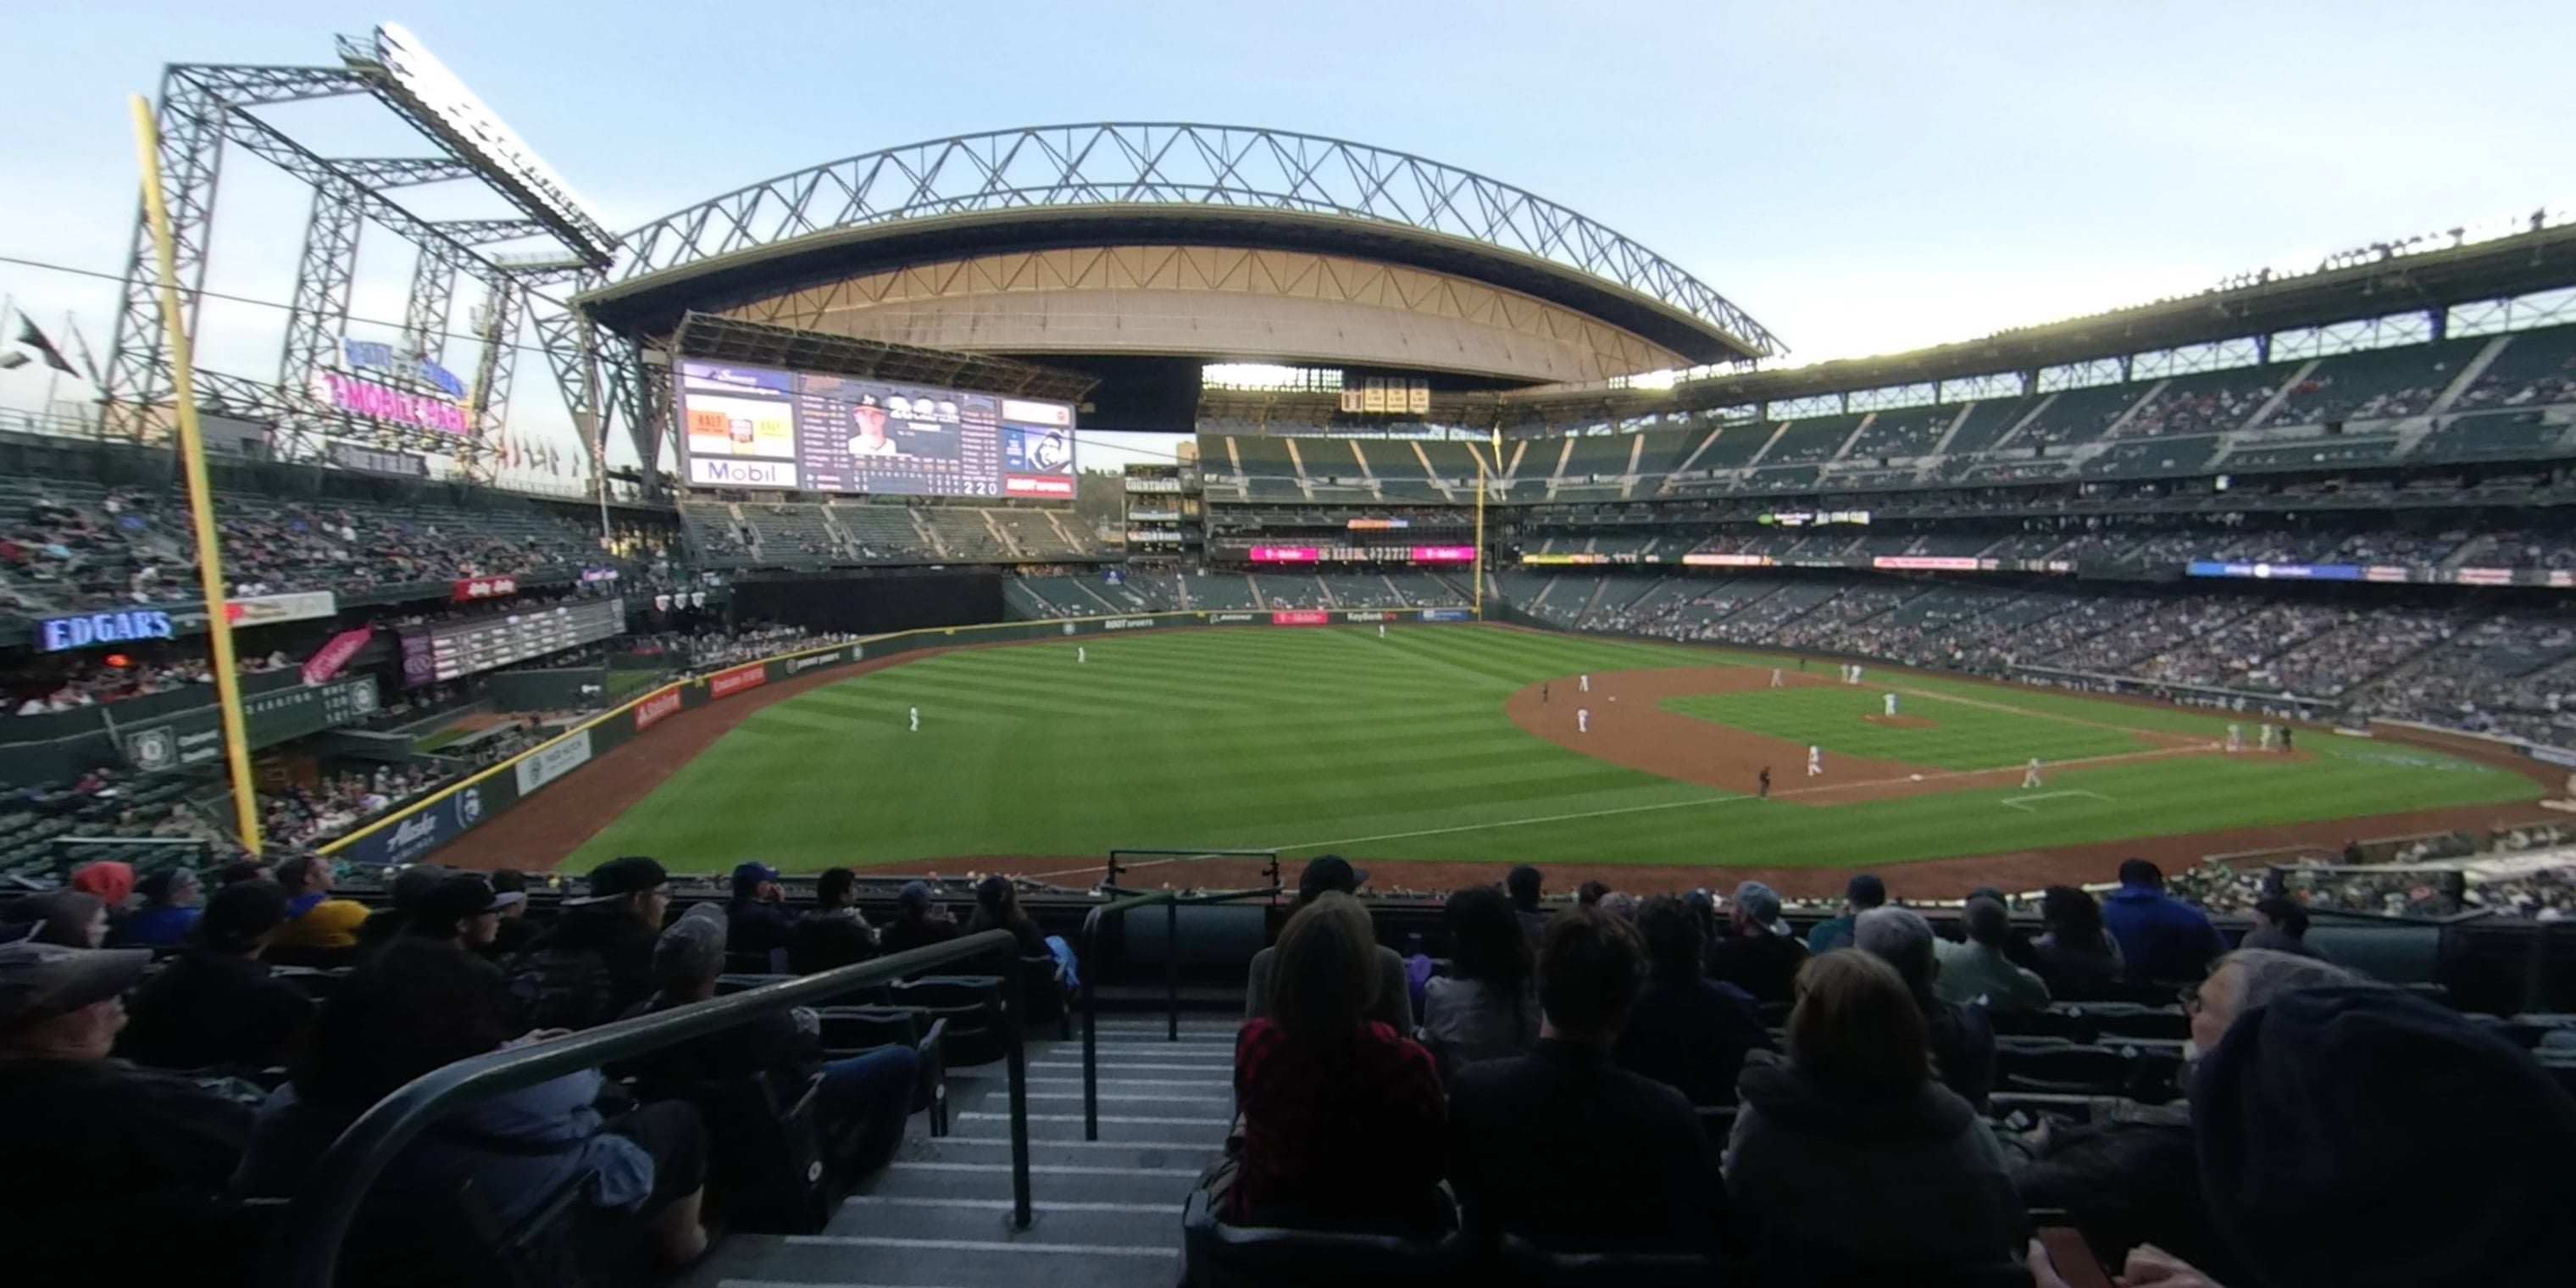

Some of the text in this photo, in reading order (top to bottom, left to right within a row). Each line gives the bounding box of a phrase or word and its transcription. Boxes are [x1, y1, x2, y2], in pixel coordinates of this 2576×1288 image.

[708, 462, 776, 481] Mobil
[963, 481, 997, 495] 2 2 0
[1105, 619, 1153, 629] ROOT SPORTS
[1347, 612, 1382, 622] KeyBank
[45, 610, 173, 652] EDGARS
